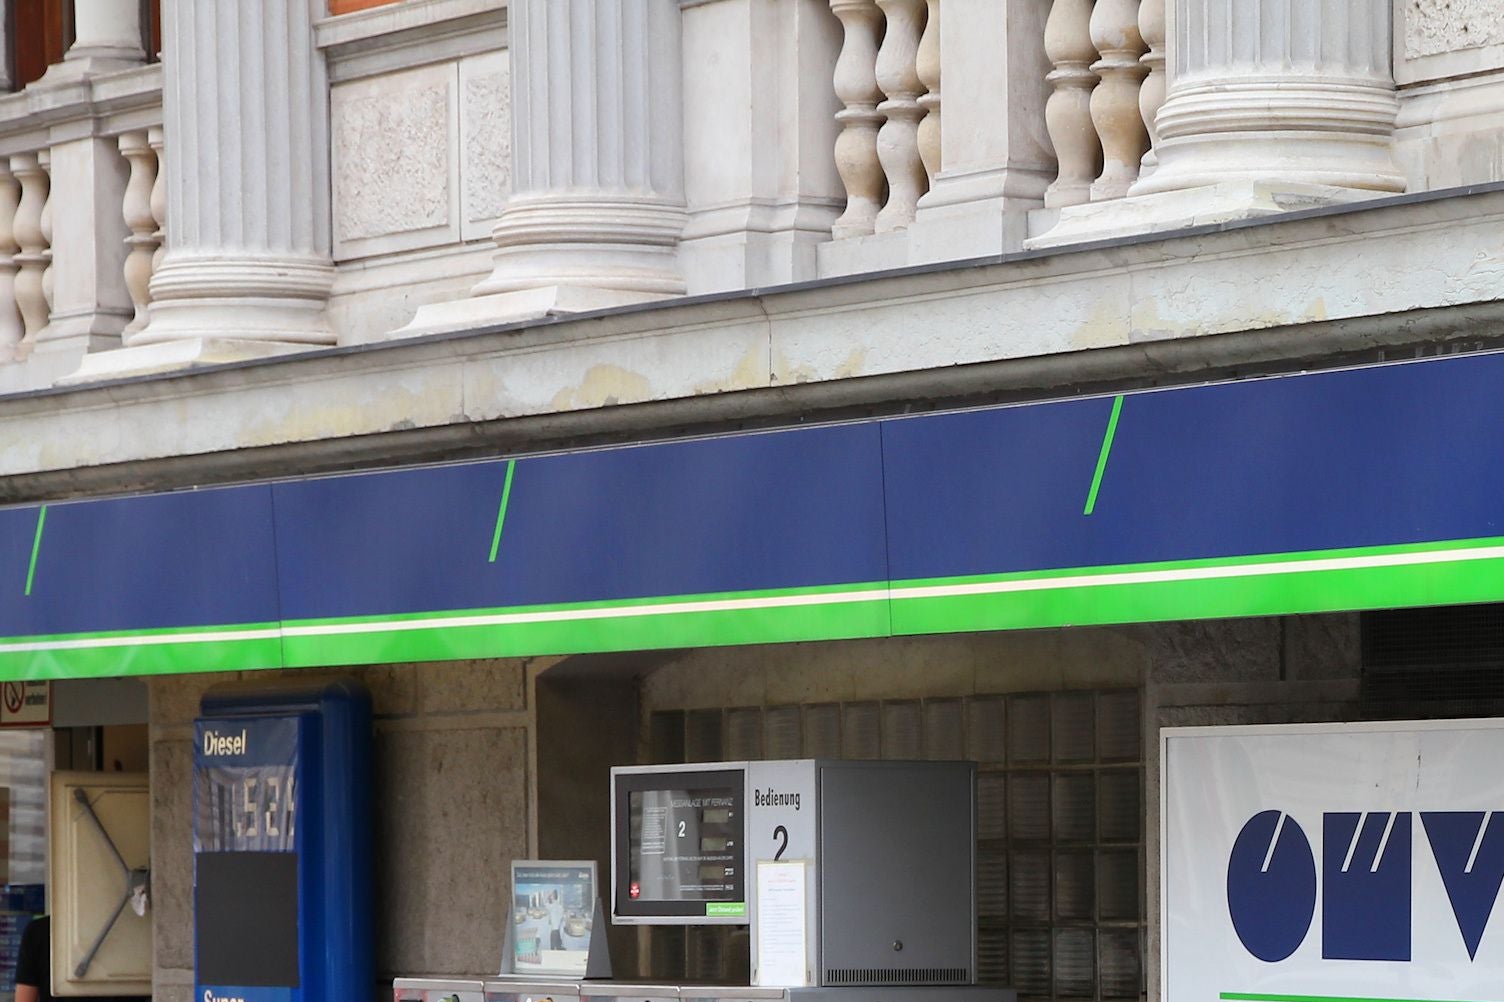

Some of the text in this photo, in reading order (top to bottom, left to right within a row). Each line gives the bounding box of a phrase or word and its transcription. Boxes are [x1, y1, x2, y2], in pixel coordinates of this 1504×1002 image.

[204, 729, 246, 756] Diesel
[754, 788, 800, 811] Bedienung
[678, 820, 686, 838] 2
[773, 825, 788, 862] 2
